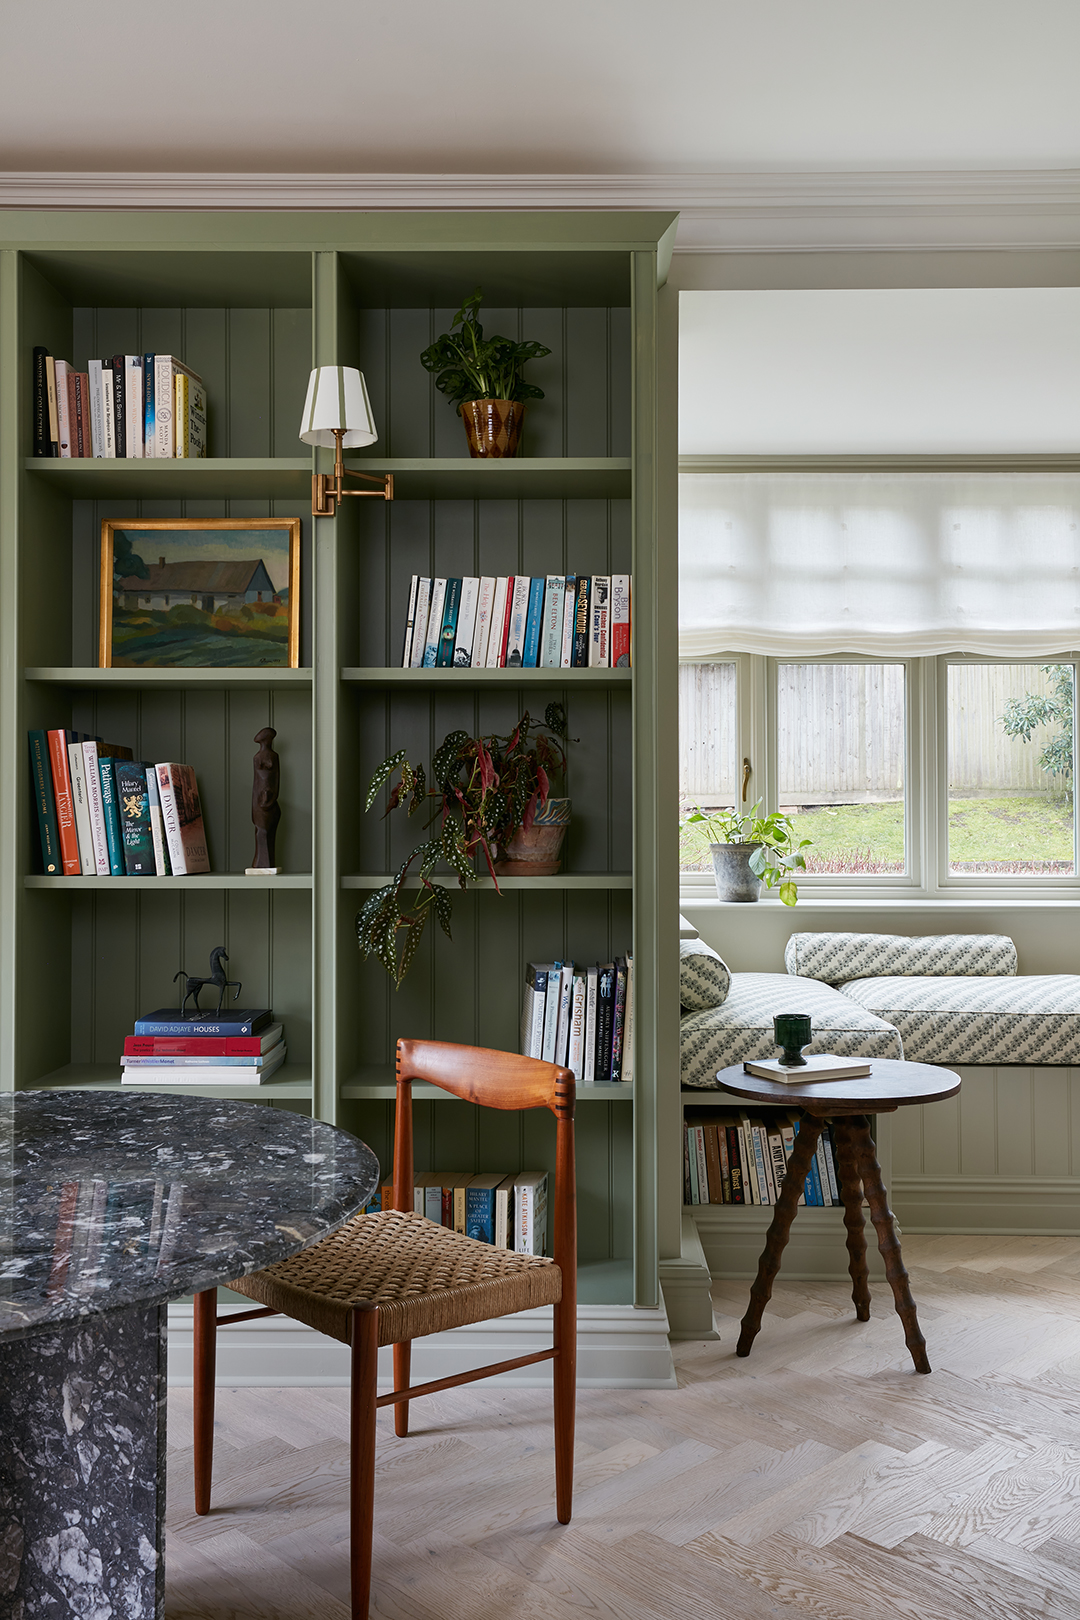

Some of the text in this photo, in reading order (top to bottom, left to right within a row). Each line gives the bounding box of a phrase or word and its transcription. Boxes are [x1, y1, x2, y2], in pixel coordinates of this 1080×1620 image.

[115, 374, 121, 383] Mr
[161, 365, 170, 406] BOUDICA
[480, 593, 490, 608] Help
[514, 579, 523, 610] STARLING
[576, 579, 588, 634] GERALD SEYMOUR
[613, 587, 623, 620] Bryson
[620, 597, 628, 611] Bill
[514, 613, 522, 642] VISIBILITY
[550, 608, 558, 630] ELTON
[36, 761, 45, 790] DESIGNERS
[88, 754, 96, 786] WILLIAM
[101, 763, 114, 804] Pathways
[40, 791, 46, 799] AT
[75, 776, 83, 805] Greenterior
[91, 787, 100, 813] MORRIS
[121, 786, 142, 794] Mantel
[58, 789, 72, 829] TANGIER
[163, 794, 176, 834] DANCER
[186, 846, 207, 857] DANCER
[536, 999, 544, 1029] POLITICAL
[547, 1005, 555, 1028] Philosophy
[573, 993, 584, 1037] Grisham
[169, 1026, 191, 1034] ADJAYE
[771, 1145, 783, 1163] ANDY
[731, 1168, 741, 1190] Ghost
[384, 1189, 392, 1199] the
